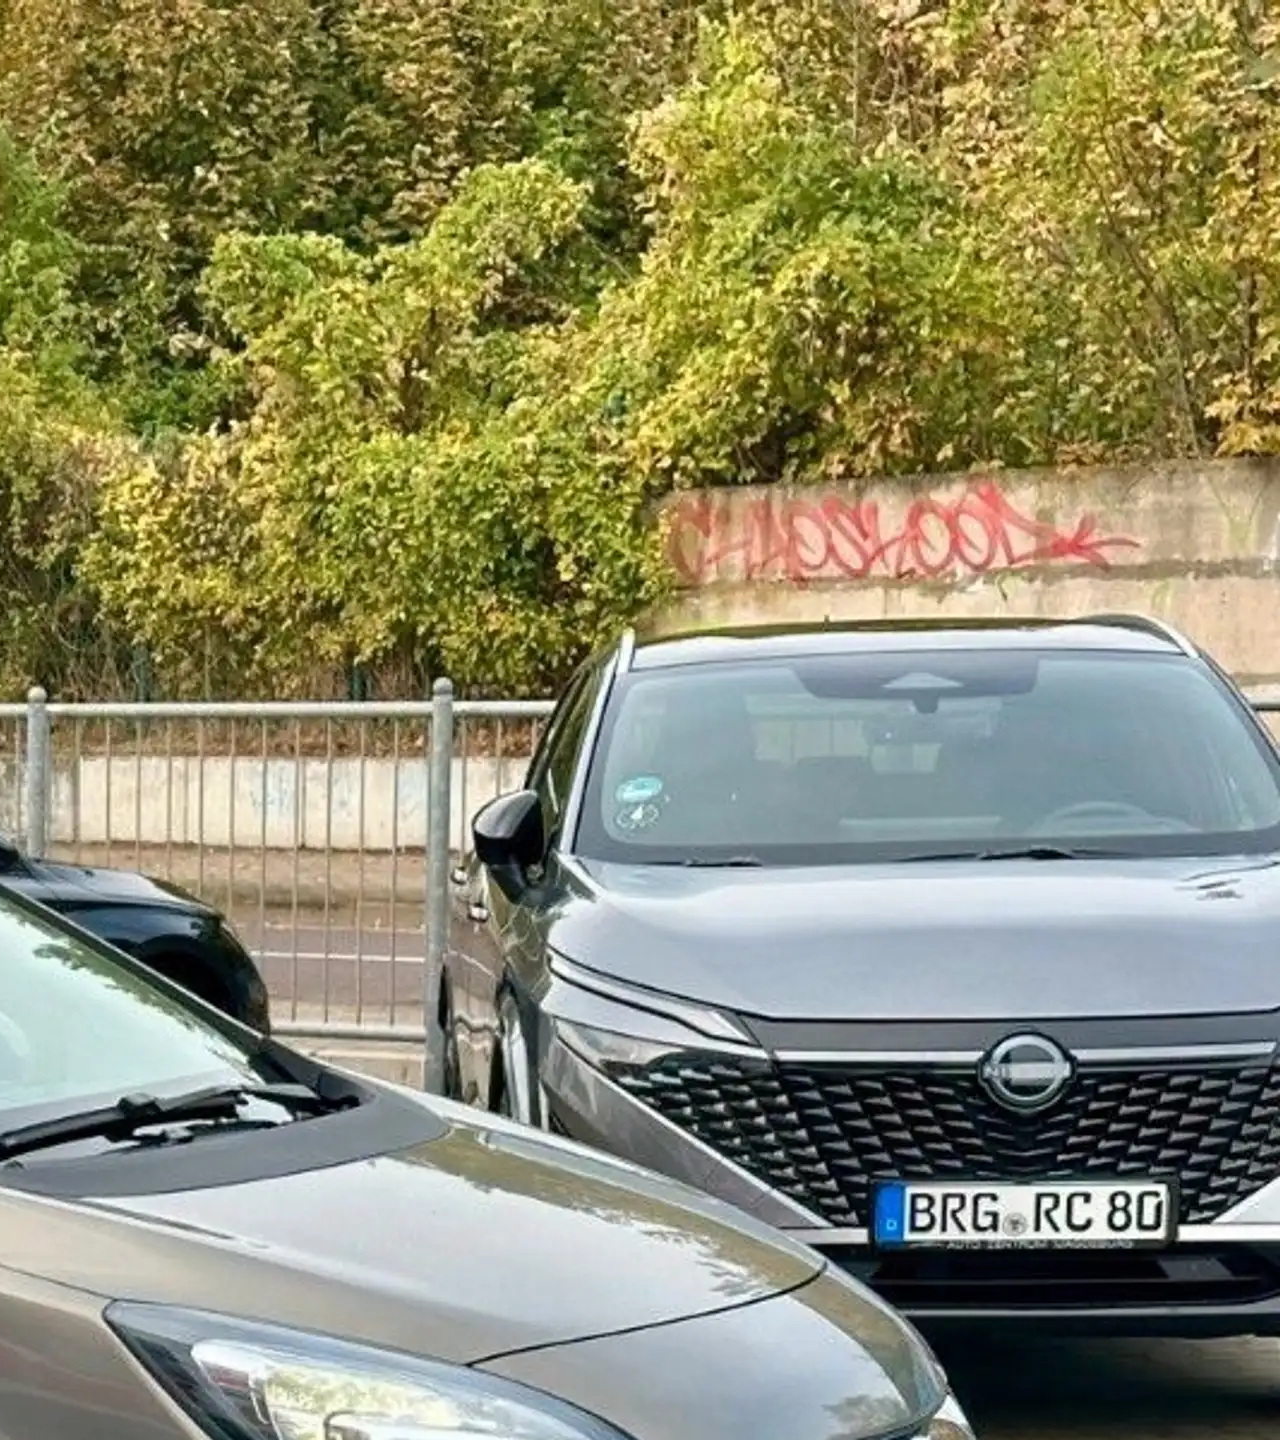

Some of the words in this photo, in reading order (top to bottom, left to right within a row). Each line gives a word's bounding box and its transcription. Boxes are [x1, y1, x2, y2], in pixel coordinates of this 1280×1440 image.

[886, 1219, 898, 1231] D
[909, 1191, 999, 1234] BRG
[1033, 1191, 1092, 1233] RC
[1107, 1190, 1165, 1232] 80
